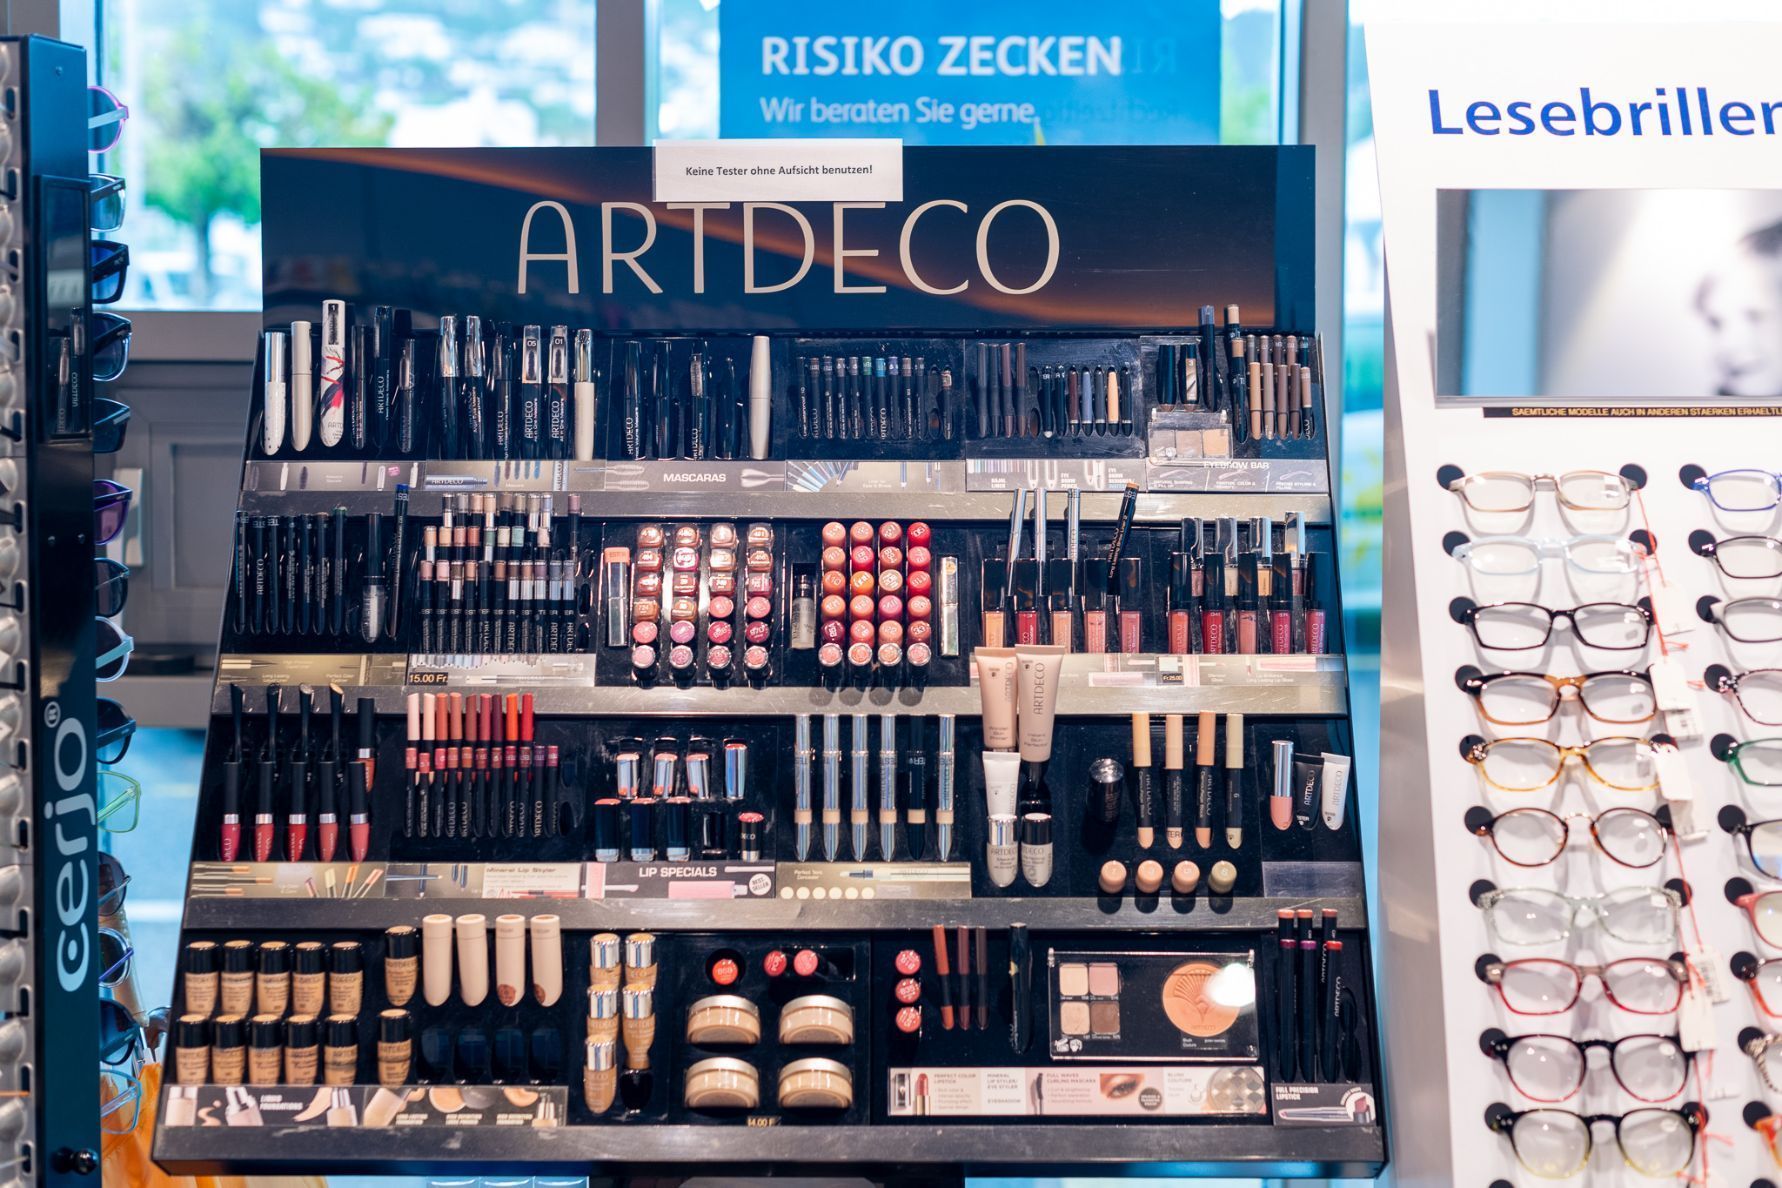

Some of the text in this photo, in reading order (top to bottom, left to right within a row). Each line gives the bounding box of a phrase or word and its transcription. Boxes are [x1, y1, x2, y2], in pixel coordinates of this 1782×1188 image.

[762, 36, 924, 77] RISIKO
[937, 36, 1121, 77] ZECKEN
[760, 97, 803, 123] Wir
[810, 96, 909, 124] beraten
[915, 96, 953, 124] Sie
[685, 165, 873, 176] Keine Tester ohne Aufsicht benutzen!
[517, 199, 1062, 296] ARTDECO
[524, 401, 533, 438] ARTDECO
[551, 401, 559, 438] ARTDECO
[1512, 408, 1567, 416] SAEMTLICHE
[1568, 408, 1609, 416] MODELLE
[1611, 408, 1635, 416] AUCH
[1636, 408, 1646, 416] IN
[1647, 408, 1688, 416] ANDEREN
[1690, 408, 1736, 416] STAERKEN
[663, 473, 727, 482] MASCARAS
[409, 675, 434, 683] 15.00
[1033, 662, 1045, 715] ARTDECO
[1304, 770, 1315, 805] ARTDECO
[639, 867, 717, 877] LIP SPECIALS
